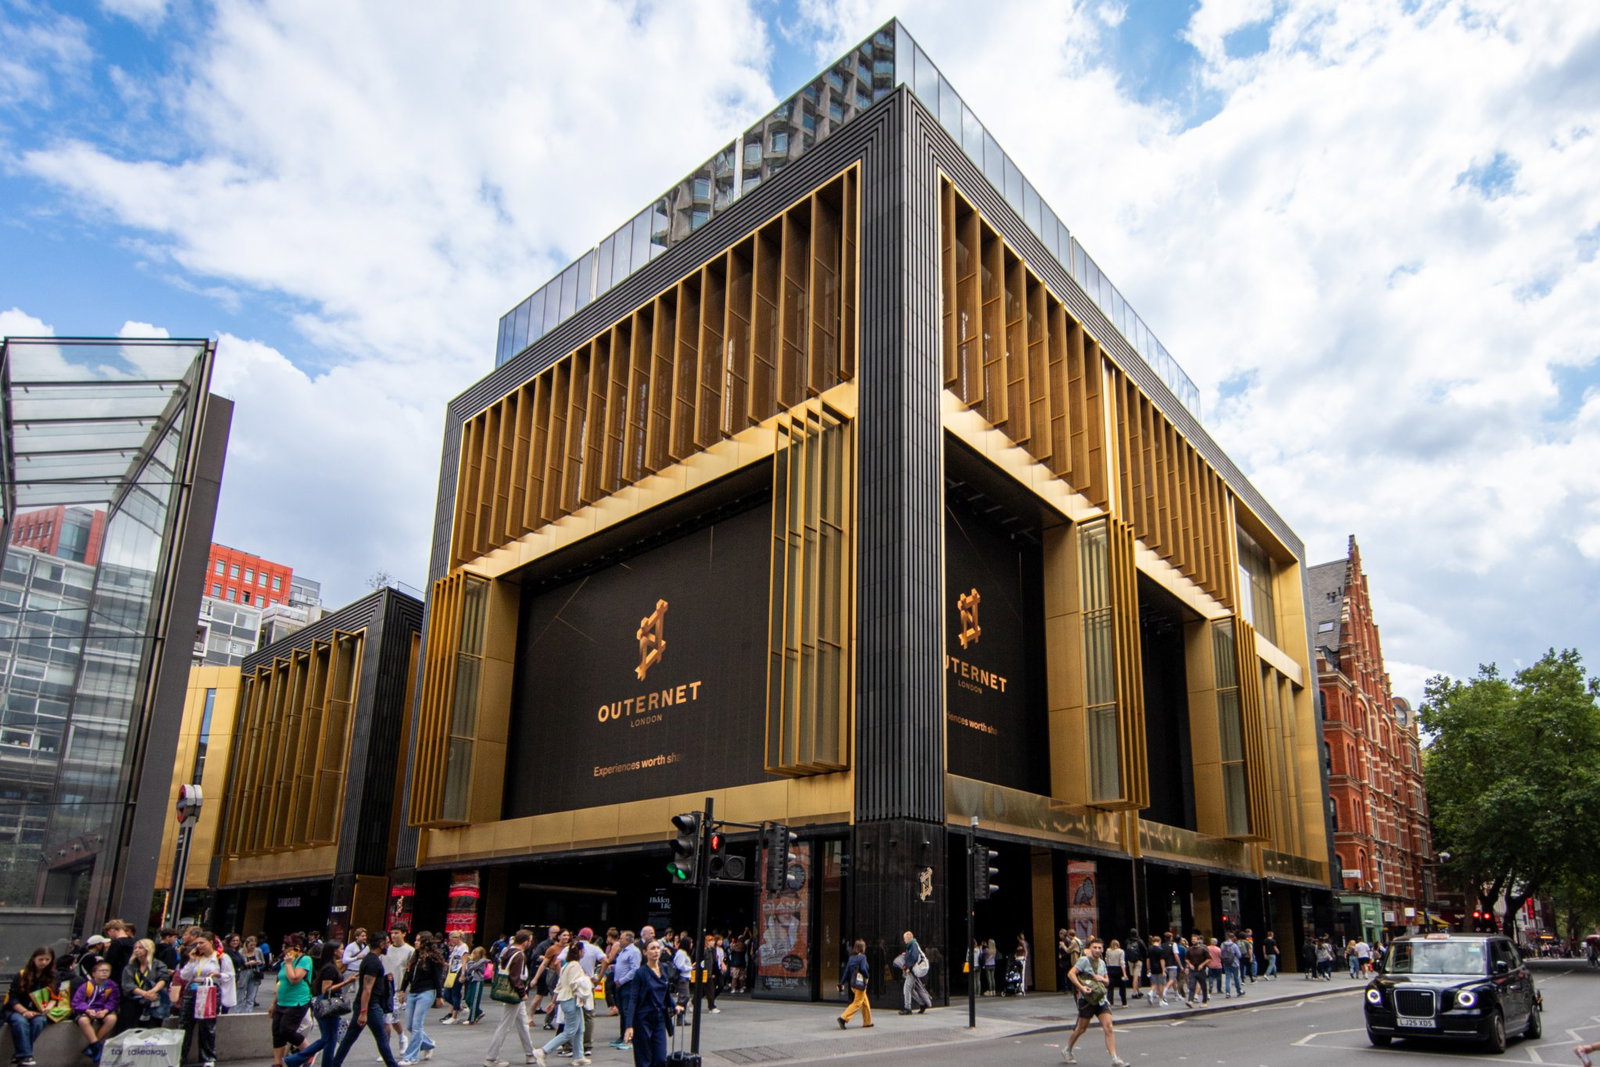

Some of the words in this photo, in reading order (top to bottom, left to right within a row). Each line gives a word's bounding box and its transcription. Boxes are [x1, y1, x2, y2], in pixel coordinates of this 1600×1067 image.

[958, 679, 983, 694] LONDON
[597, 680, 702, 723] OUTERNET
[630, 714, 663, 728] LONDON
[969, 719, 988, 732] worth
[593, 761, 641, 777] Experiences
[641, 755, 666, 768] worth
